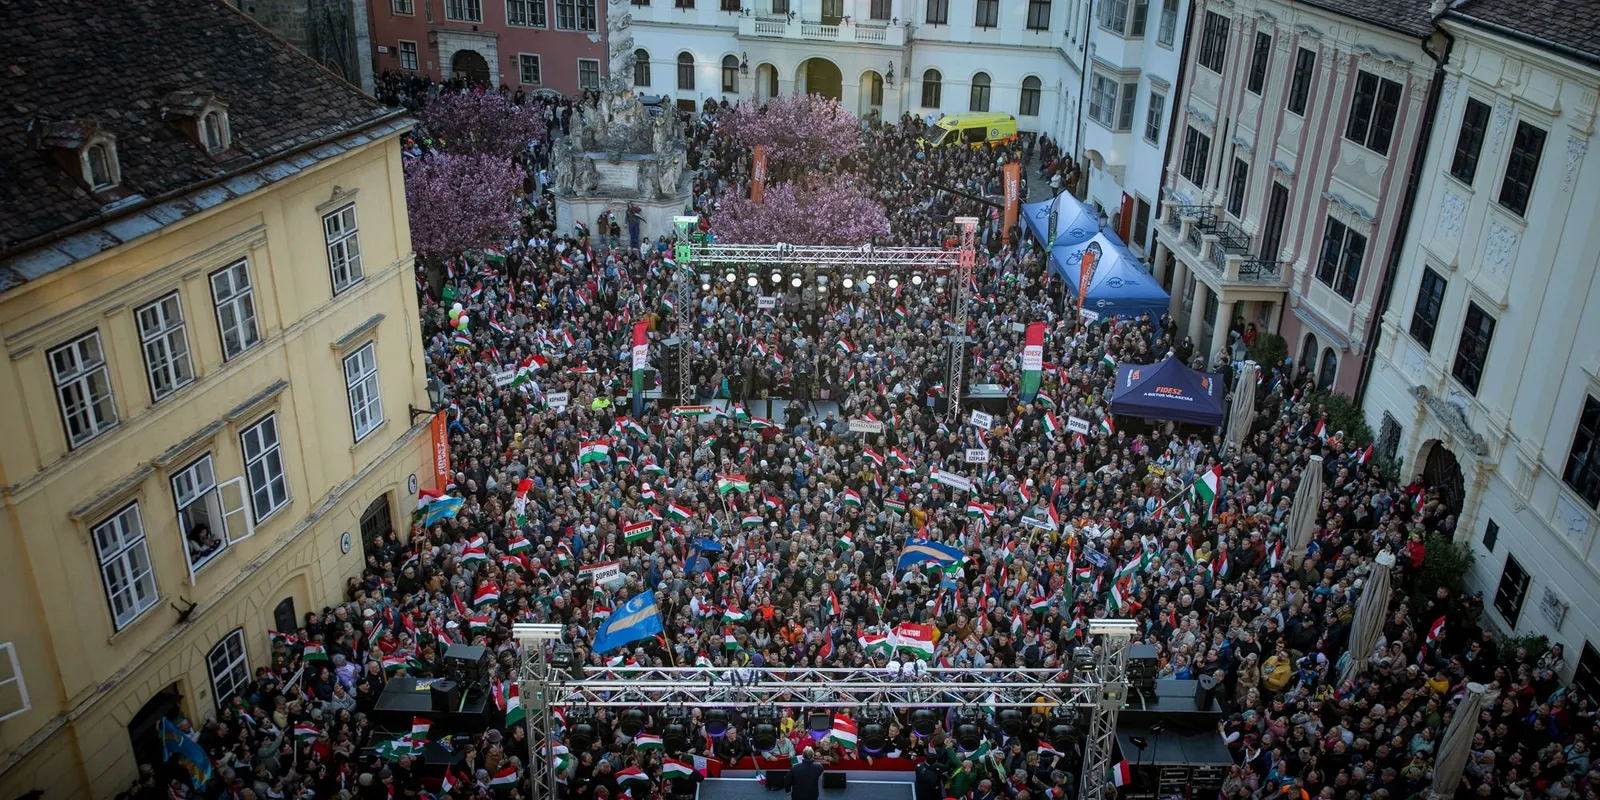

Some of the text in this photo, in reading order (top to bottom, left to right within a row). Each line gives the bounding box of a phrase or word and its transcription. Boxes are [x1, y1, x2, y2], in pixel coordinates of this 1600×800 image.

[1155, 386, 1182, 395] FIDESZ
[1166, 393, 1194, 401] VÁLASZTÁS
[1070, 419, 1087, 430] SOPRON
[436, 442, 445, 475] FIDESZ
[627, 527, 650, 537] BELED
[595, 568, 618, 580] SOPRON
